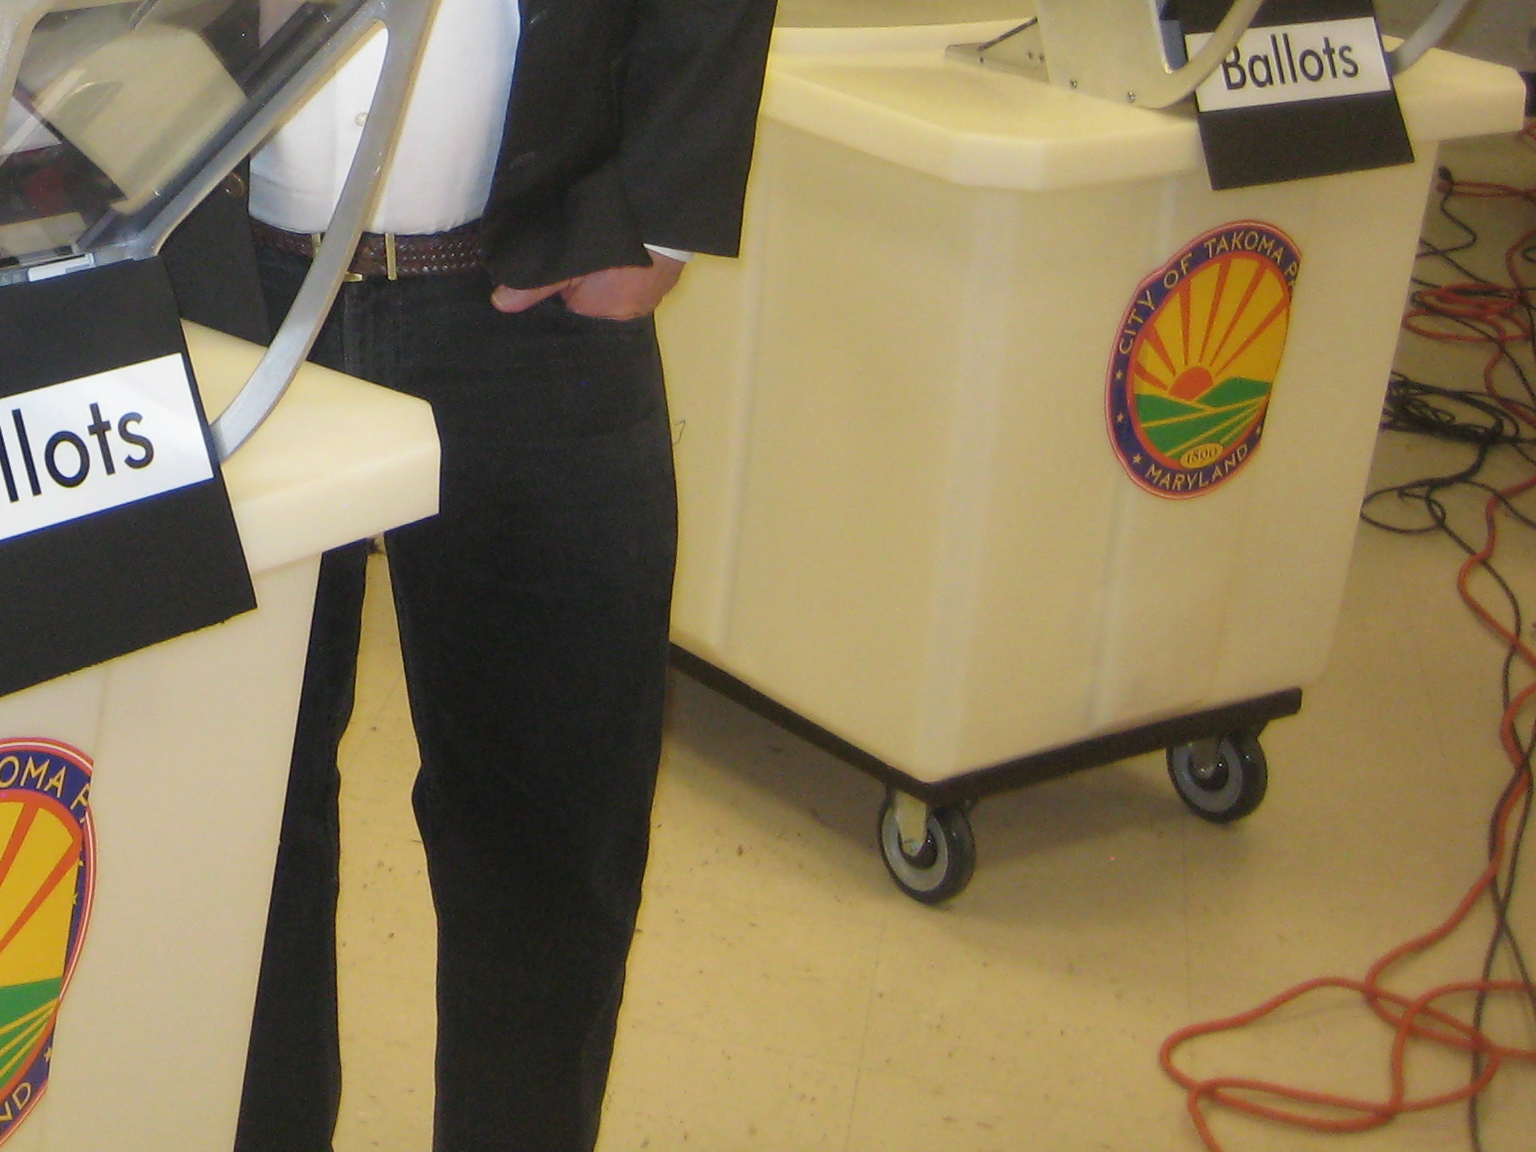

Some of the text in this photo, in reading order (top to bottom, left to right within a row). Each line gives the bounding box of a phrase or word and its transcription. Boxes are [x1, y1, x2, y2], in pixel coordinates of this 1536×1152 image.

[1220, 32, 1359, 91] Ballots
[1118, 290, 1157, 355] CITY
[1163, 252, 1194, 290] OF
[1204, 230, 1283, 264] TAKOMA
[1146, 443, 1249, 491] MARYLAND
